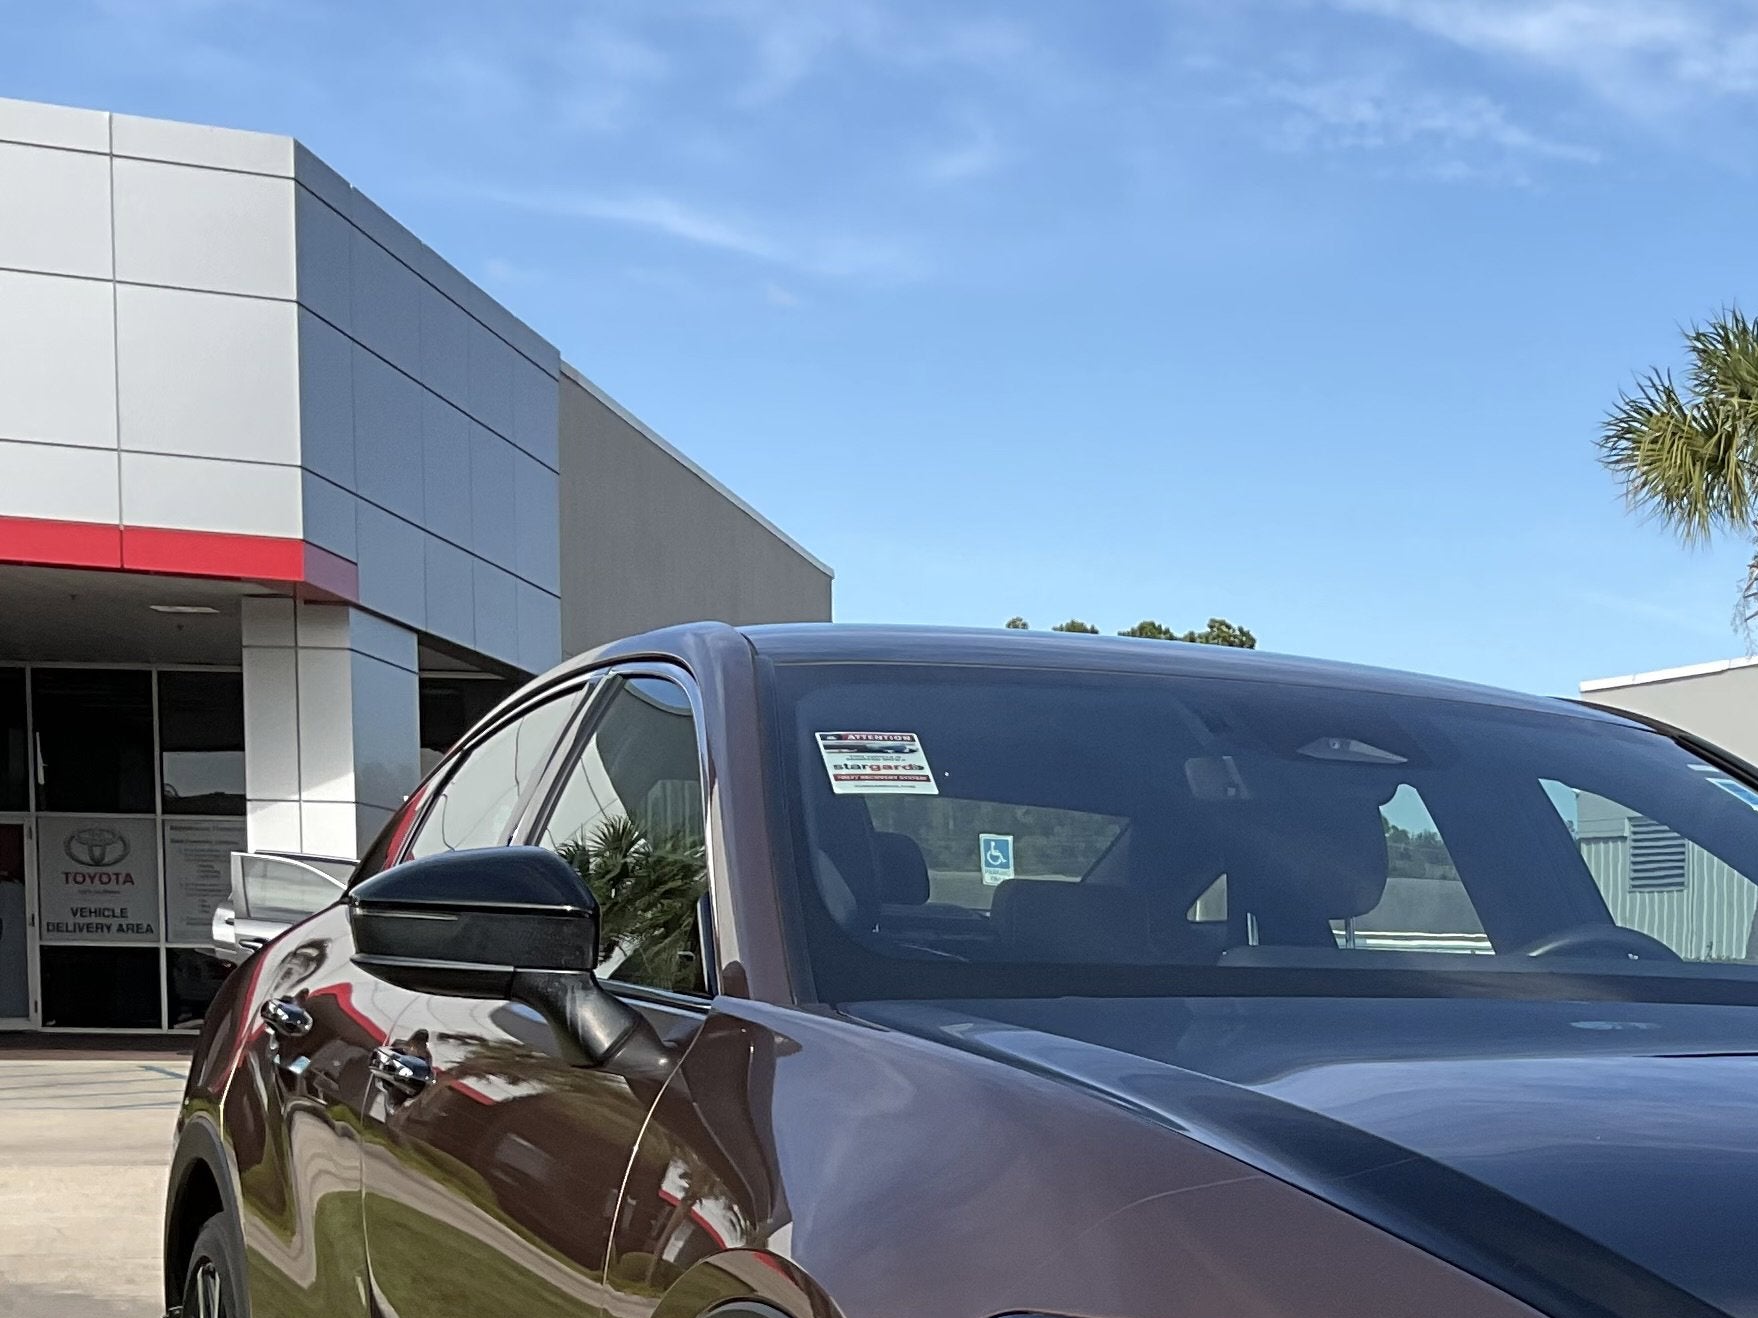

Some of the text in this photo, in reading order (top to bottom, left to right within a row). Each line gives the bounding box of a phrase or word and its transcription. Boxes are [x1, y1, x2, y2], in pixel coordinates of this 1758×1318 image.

[833, 763, 914, 771] stargard
[63, 872, 135, 886] TOYOTA
[70, 907, 128, 919] VEHICLE
[46, 921, 154, 935] DELIVERY AREA
